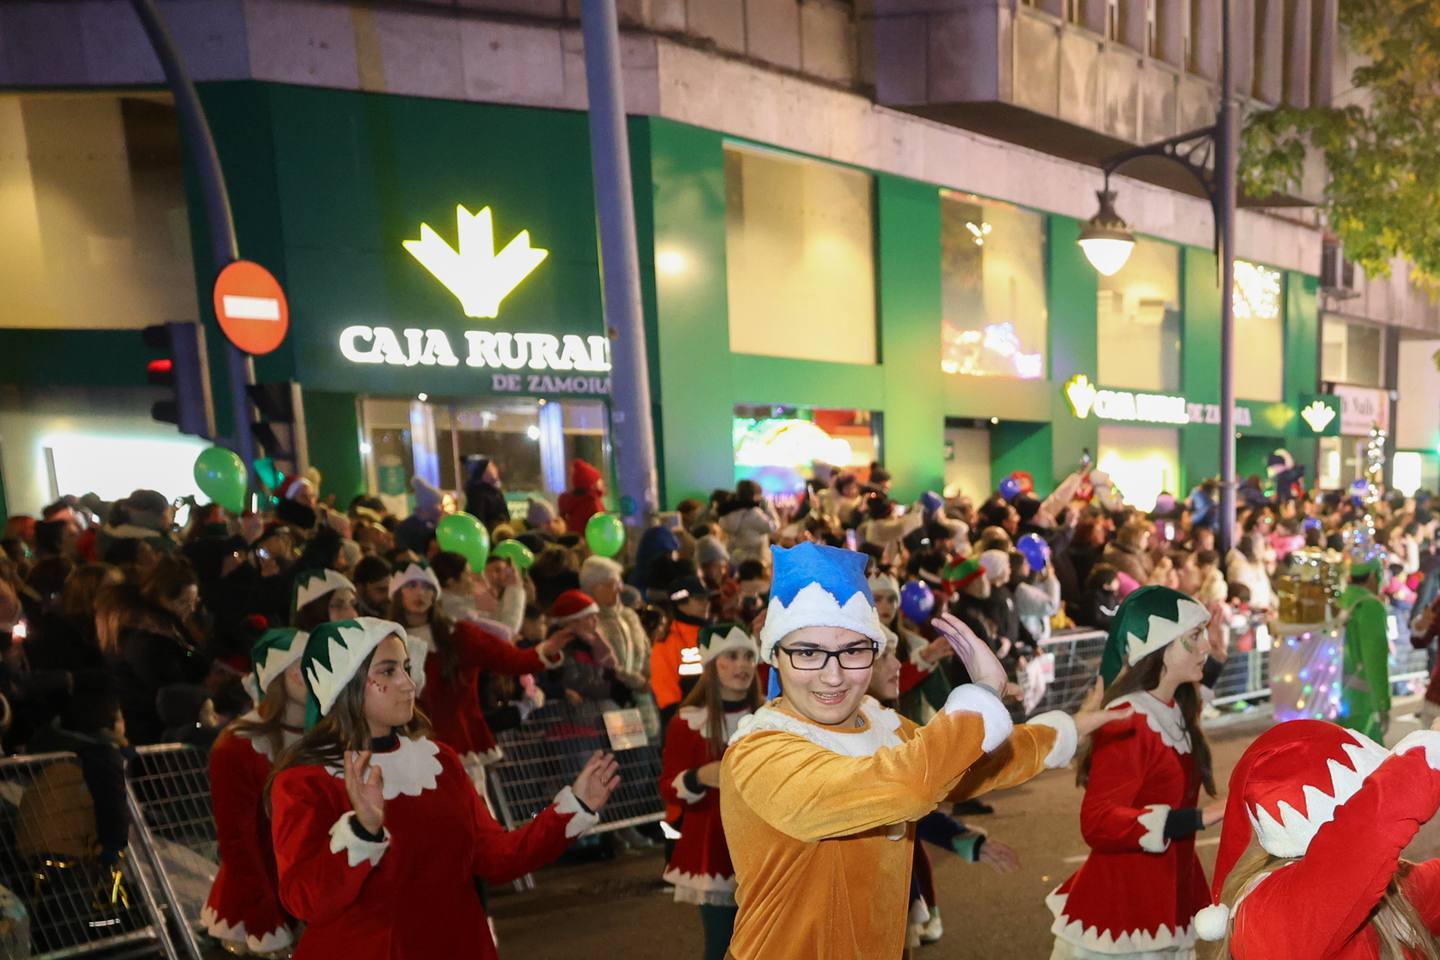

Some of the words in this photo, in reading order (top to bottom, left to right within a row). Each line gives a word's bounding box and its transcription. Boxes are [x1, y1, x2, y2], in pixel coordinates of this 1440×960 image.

[339, 325, 459, 367] CAJA
[464, 330, 612, 371] RURAL
[492, 373, 522, 392] DE
